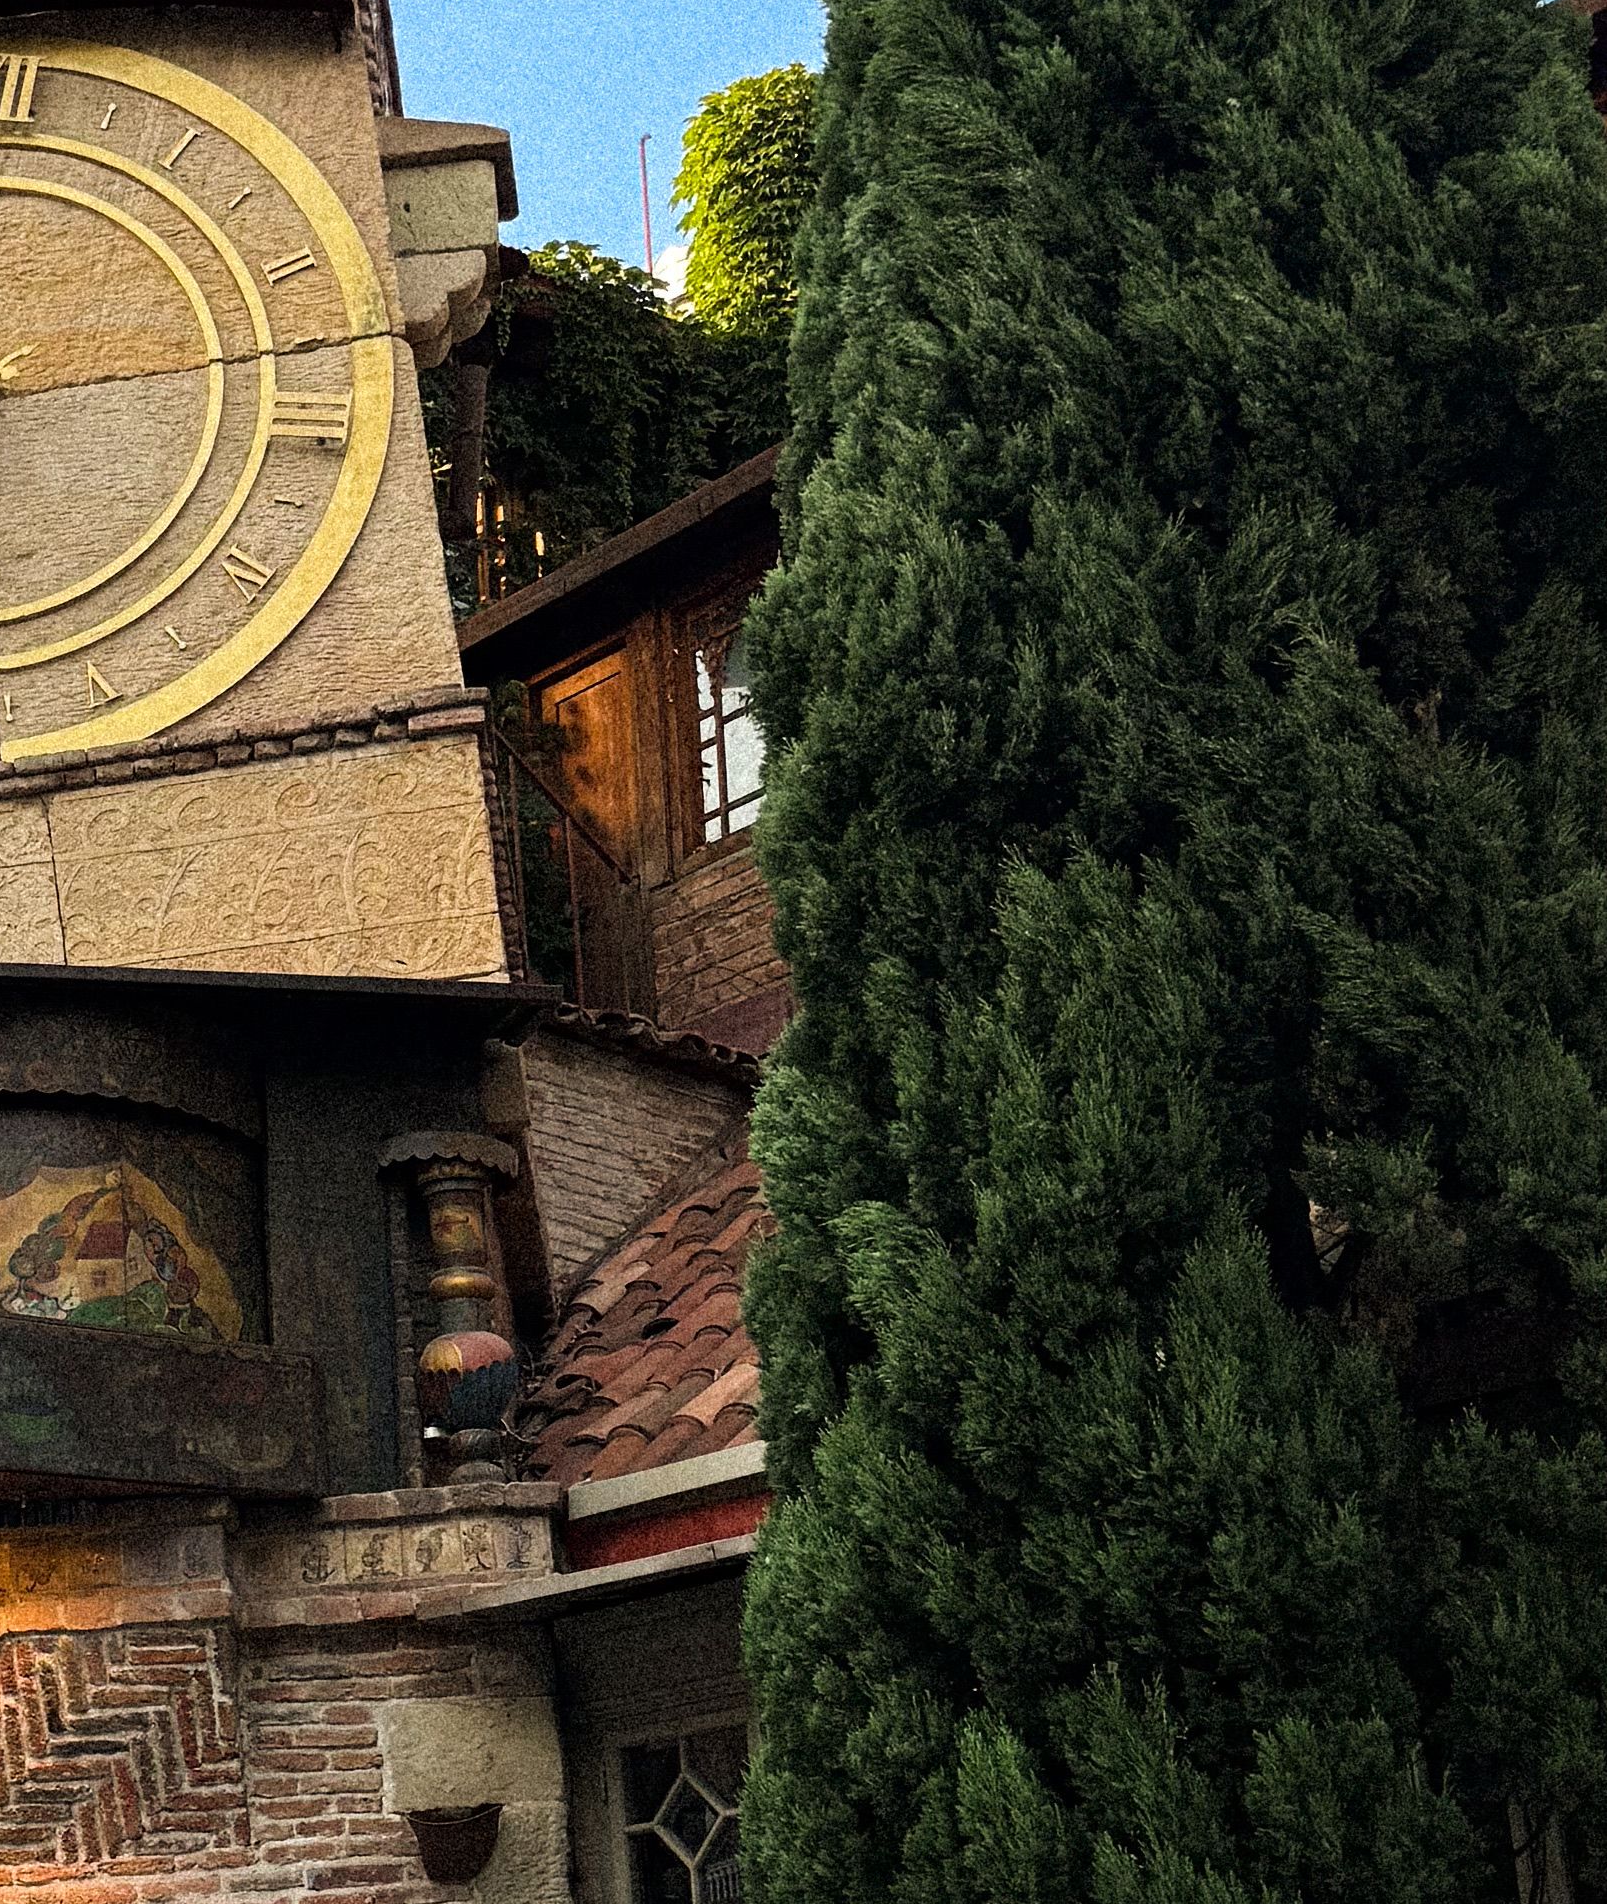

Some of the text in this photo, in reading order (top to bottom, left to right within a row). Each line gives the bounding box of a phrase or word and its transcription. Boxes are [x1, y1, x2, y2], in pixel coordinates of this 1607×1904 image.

[158, 127, 202, 171] I
[260, 244, 317, 287] II
[267, 385, 354, 444] III
[221, 542, 278, 604] IV
[86, 660, 124, 710] V
